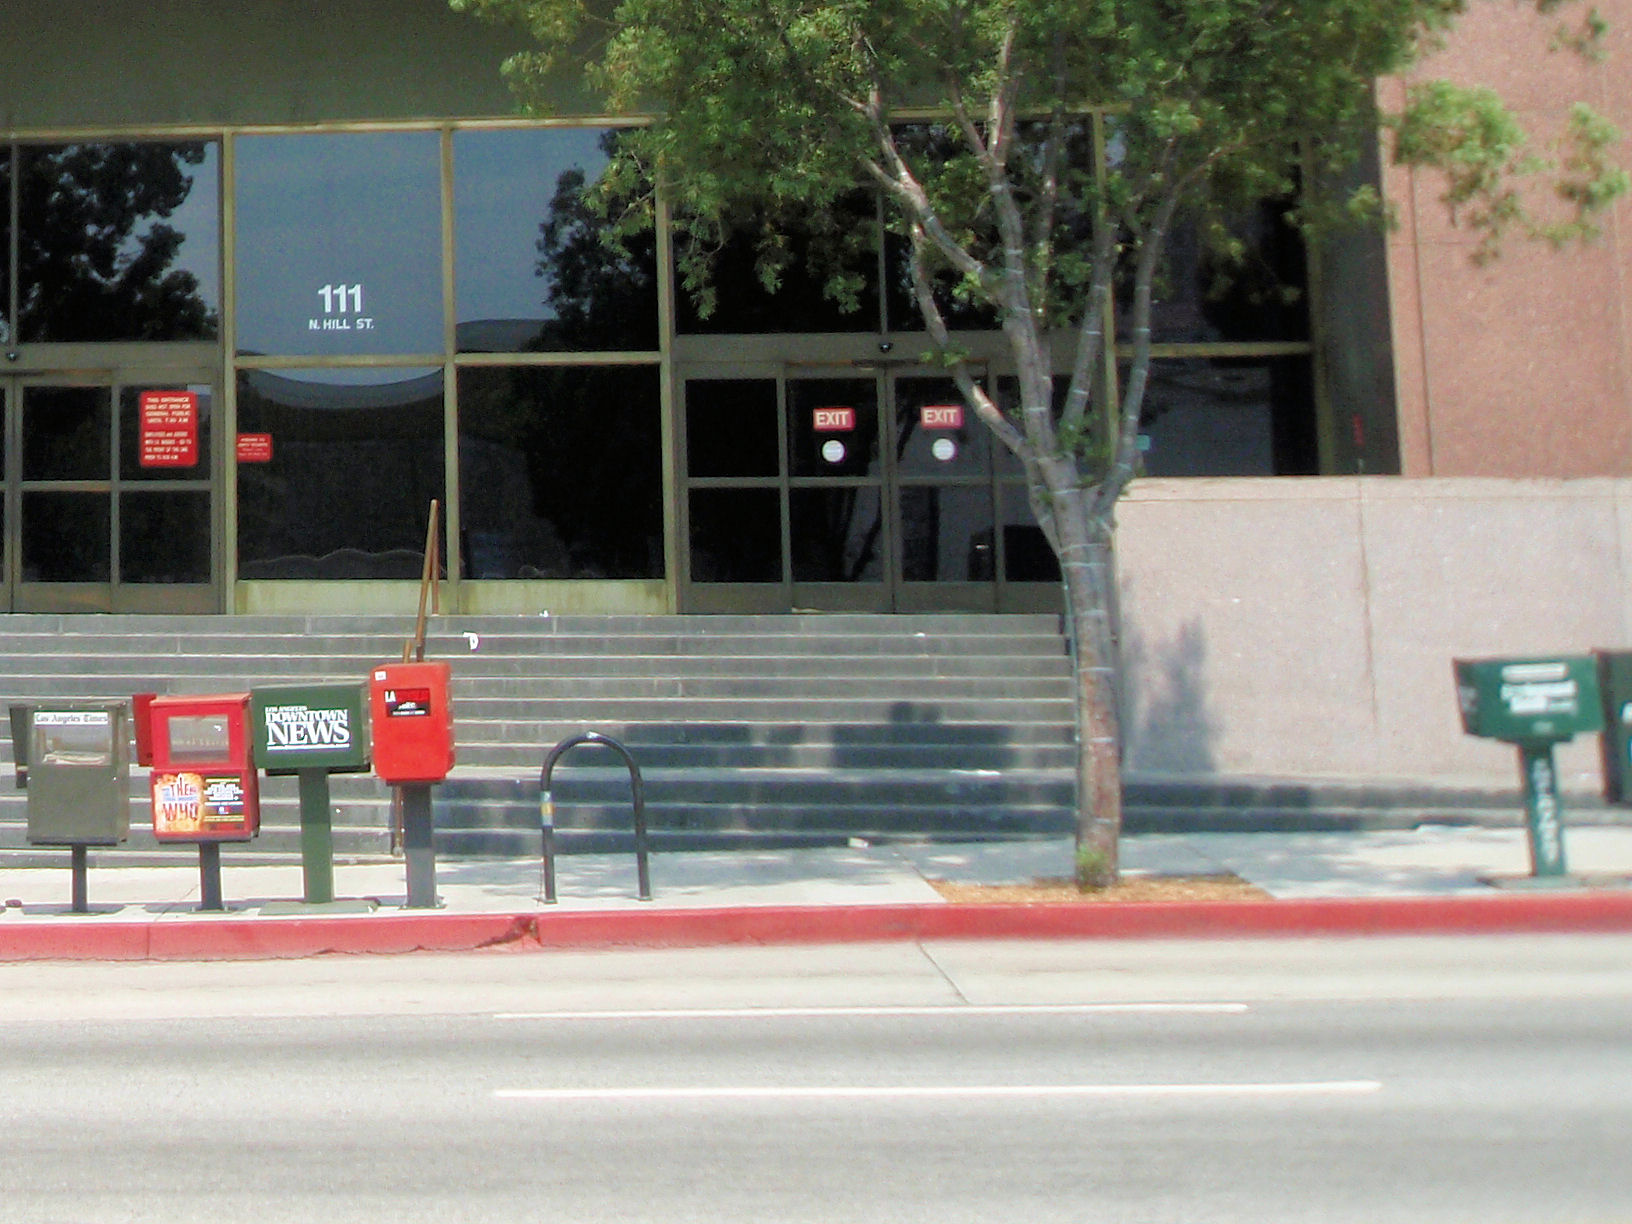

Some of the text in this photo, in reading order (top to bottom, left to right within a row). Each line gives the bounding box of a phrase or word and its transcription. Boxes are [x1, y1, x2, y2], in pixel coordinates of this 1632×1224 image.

[317, 284, 361, 313] 111
[323, 319, 351, 330] HILL
[356, 318, 375, 330] ST.
[815, 411, 849, 426] EXIT
[923, 409, 957, 424] EXIT
[384, 690, 397, 703] LA
[265, 709, 348, 724] DOWNTOWN
[267, 722, 350, 745] NEWS
